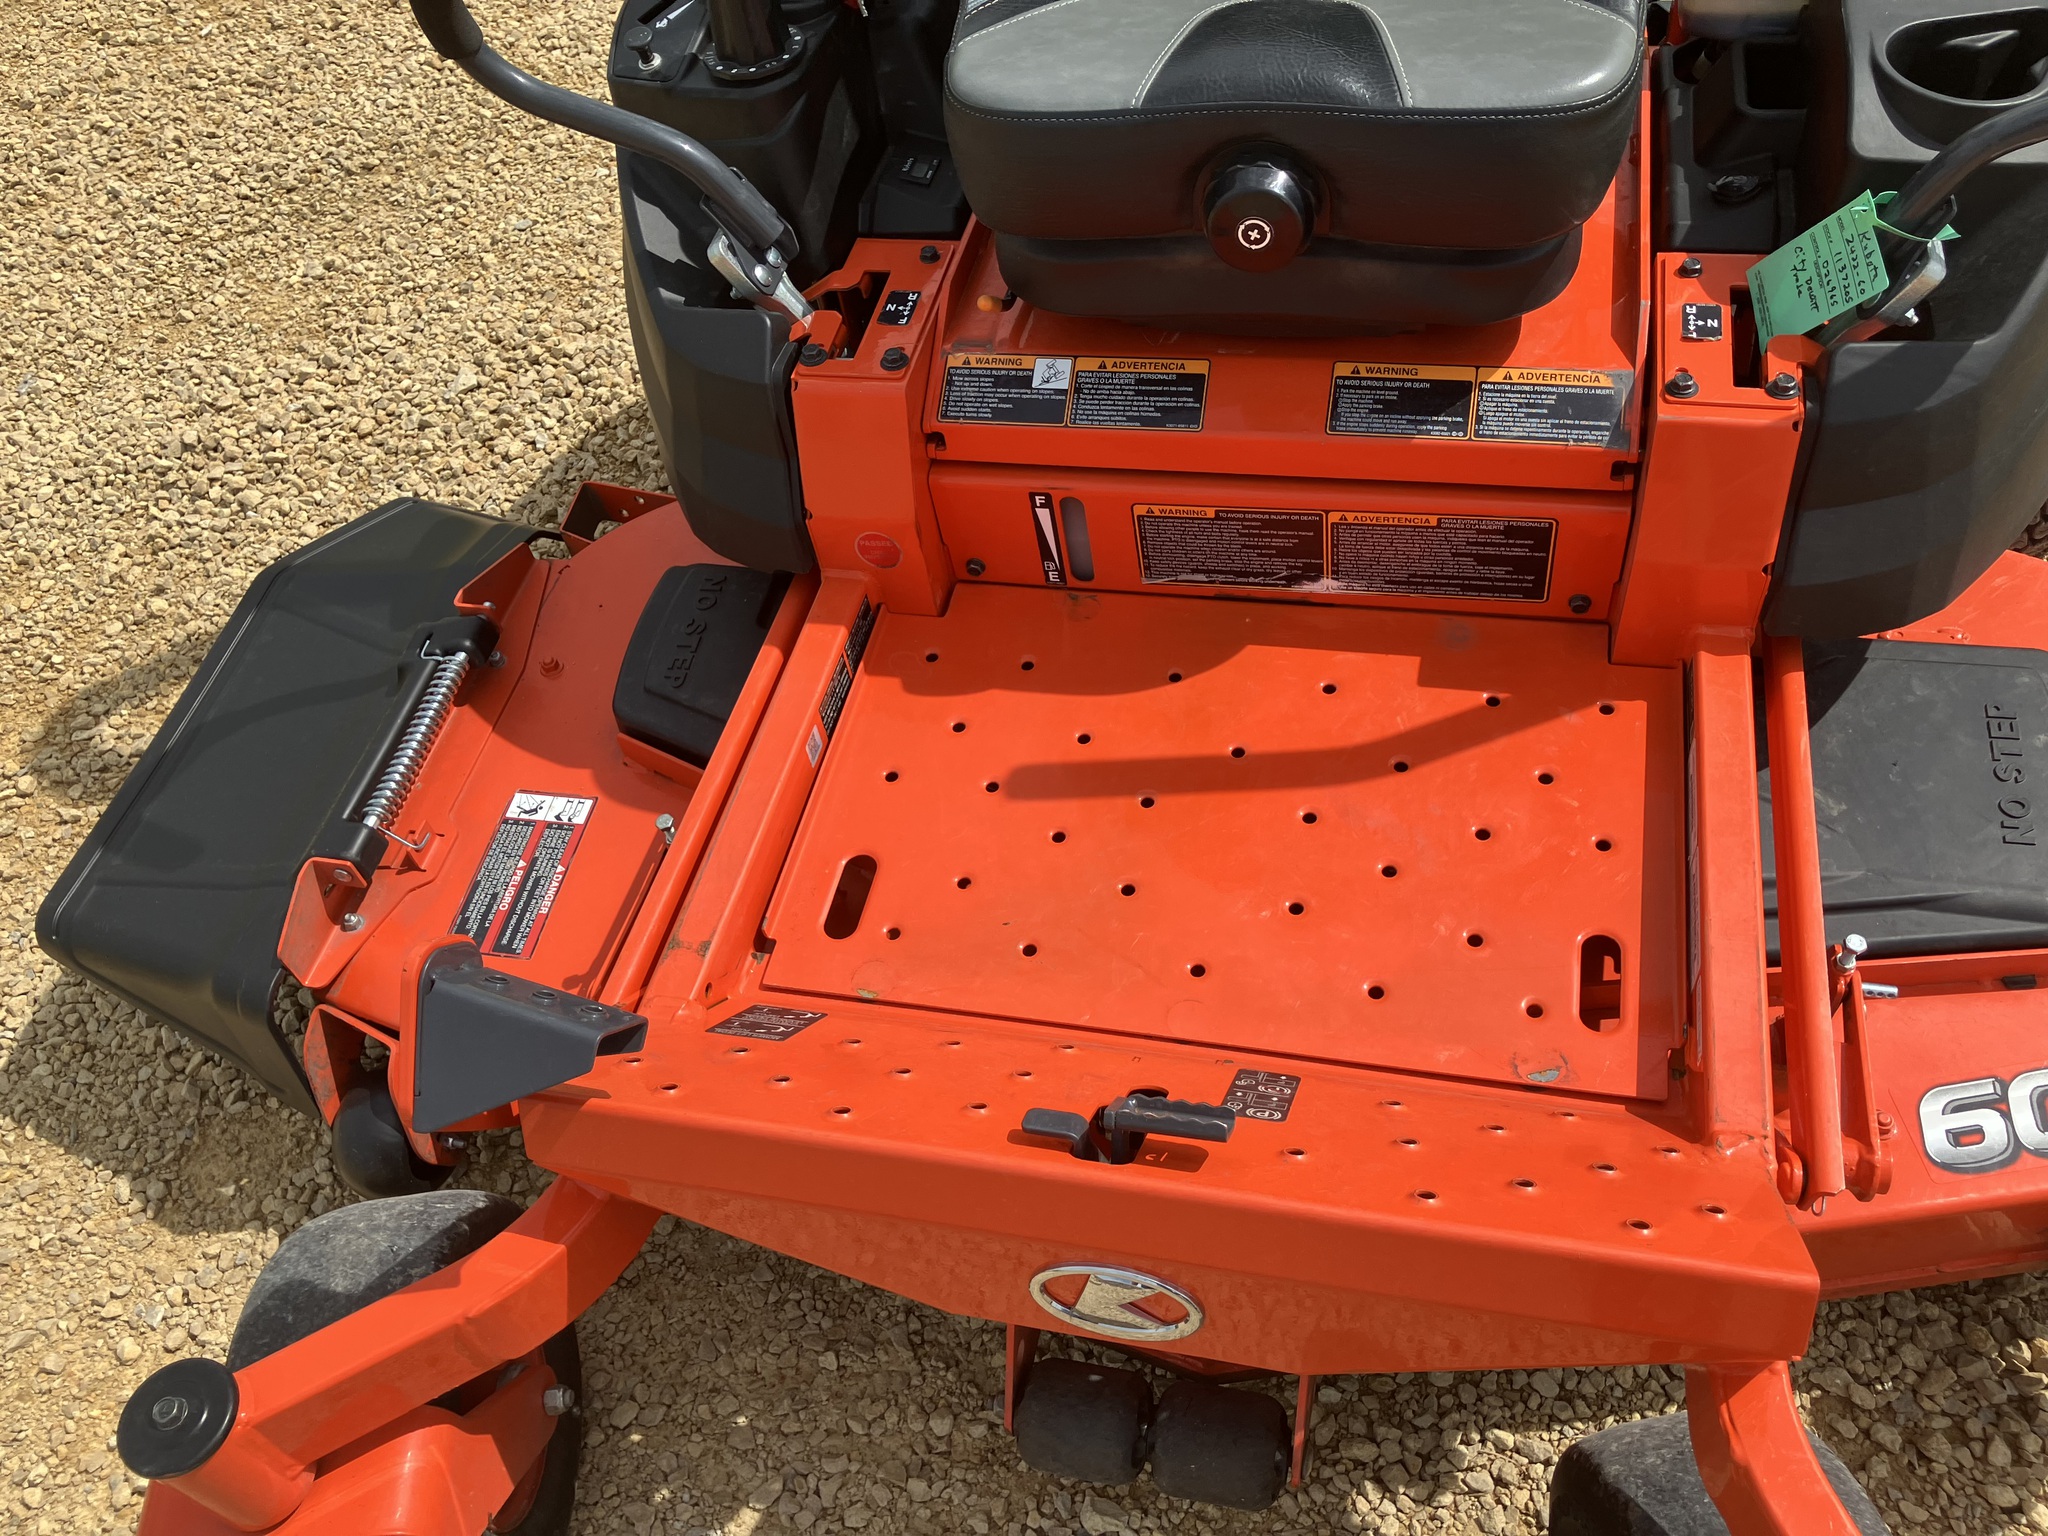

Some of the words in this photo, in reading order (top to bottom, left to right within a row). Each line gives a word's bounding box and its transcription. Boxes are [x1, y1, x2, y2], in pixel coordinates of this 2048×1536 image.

[908, 293, 918, 301] R
[886, 303, 897, 312] N
[1685, 305, 1697, 314] R
[1707, 318, 1718, 328] N
[974, 357, 1022, 365] WARNING
[1111, 361, 1186, 370] ADVERTENCIA
[1364, 366, 1418, 376] WARNING
[1517, 372, 1601, 383] ADVERTENCIA
[1035, 495, 1046, 507] F
[1158, 508, 1206, 516] WARNING
[1352, 515, 1430, 524] ADVERTENCIA
[1048, 571, 1060, 582] E
[695, 576, 728, 611] NO
[664, 618, 707, 689] STEP
[1984, 703, 2027, 785] STEP
[1998, 794, 2037, 846] NO
[542, 837, 552, 847] NOT
[562, 830, 572, 842] STAY
[554, 838, 563, 848] NOT
[549, 849, 558, 858] PUT
[555, 842, 567, 859] CLEAR
[533, 847, 547, 870] OPERATE
[552, 859, 559, 867] OF
[542, 859, 554, 875] HANDS
[524, 870, 537, 890] MOWER
[538, 876, 546, 884] OR
[540, 867, 556, 895] DISCHARGE
[497, 869, 523, 910] PELIGRO
[532, 885, 542, 898] FEET
[538, 874, 562, 914] DANGER
[514, 890, 528, 913] WITHOUT
[527, 898, 537, 911] INTO
[529, 896, 544, 919] OPENING
[518, 911, 531, 931] MOWER
[500, 914, 518, 945] DISCHARGE
[522, 927, 530, 937] ALL
[511, 932, 522, 948] WHEN
